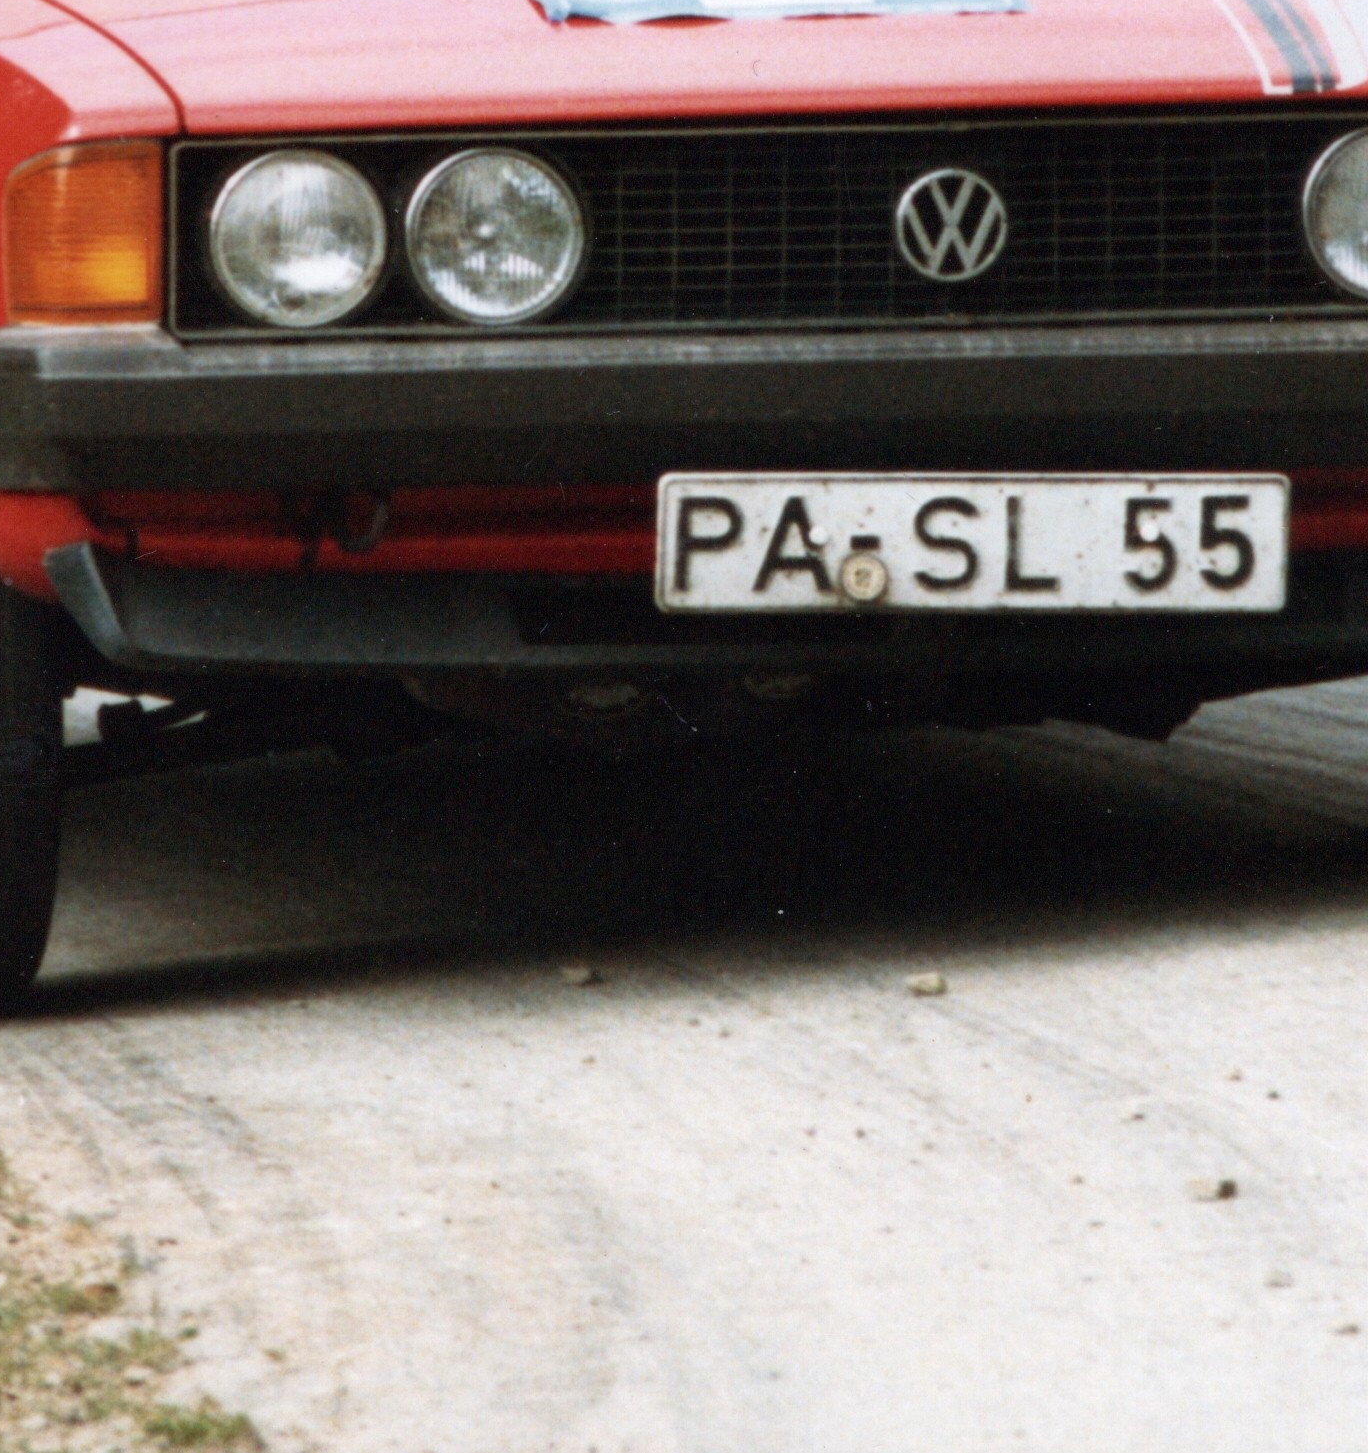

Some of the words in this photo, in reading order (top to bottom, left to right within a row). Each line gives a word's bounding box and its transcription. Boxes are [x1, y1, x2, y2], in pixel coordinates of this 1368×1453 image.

[897, 169, 1007, 282] VW
[673, 495, 1059, 593] PA-SL
[1123, 494, 1255, 593] 55
